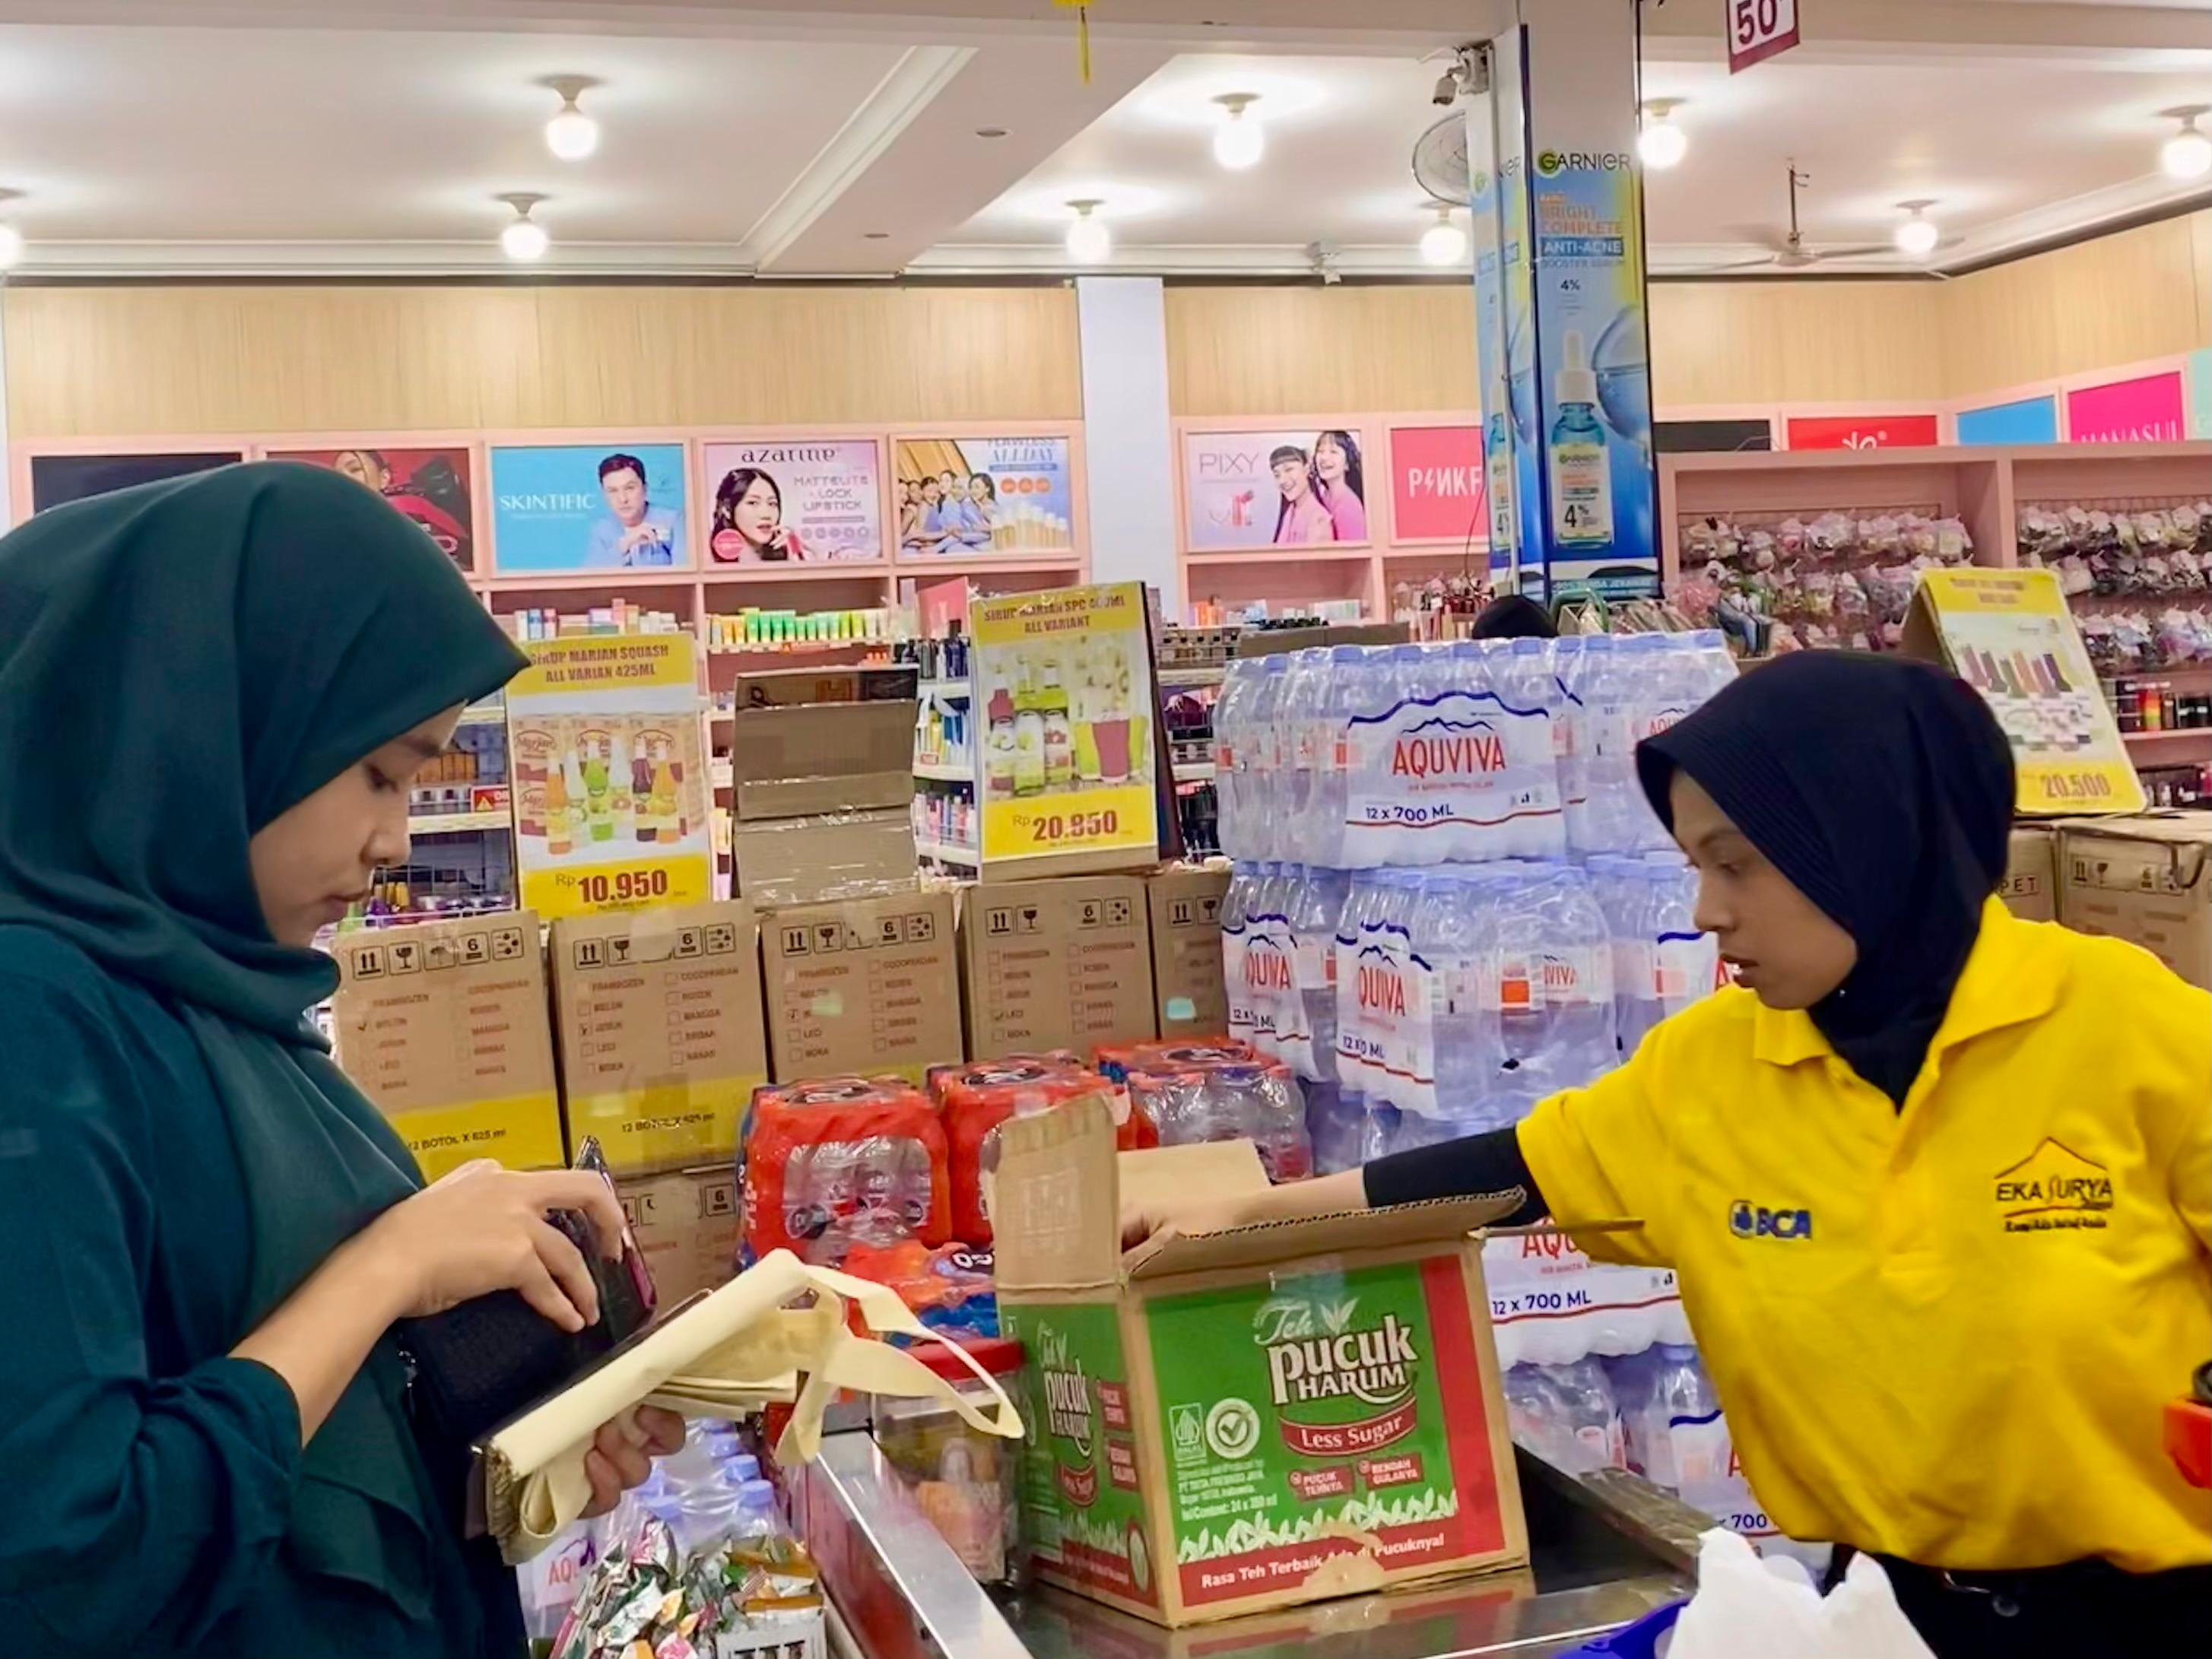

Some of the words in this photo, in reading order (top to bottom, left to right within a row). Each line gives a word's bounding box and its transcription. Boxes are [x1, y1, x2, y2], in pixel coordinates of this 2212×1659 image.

[1544, 239, 1622, 254] ANTI-ACNE
[1199, 452, 1260, 475] PIXY
[1408, 465, 1482, 499] PINKF
[499, 493, 597, 511] SKINTIFIC
[620, 644, 669, 661] SQUASH
[545, 669, 565, 683] ALL
[1392, 735, 1506, 779] AQUVIVA
[2041, 773, 2112, 798] 20.500
[1365, 807, 1378, 820] 12
[1393, 806, 1428, 822] 700
[1432, 804, 1455, 818] ML
[555, 874, 576, 889] Rp
[578, 869, 668, 904] 10.950
[884, 921, 894, 933] 6
[467, 938, 478, 950] 6
[682, 933, 693, 945] 6
[422, 1136, 459, 1150] BOTOL
[462, 1134, 470, 1143] X
[715, 1189, 725, 1203] 6
[1996, 1181, 2043, 1201] EKA
[2045, 1175, 2113, 1204] SURYA
[1756, 1207, 1813, 1239] BCA
[1492, 1299, 1506, 1315] 12
[1525, 1292, 1562, 1310] 700
[1566, 1291, 1592, 1308] ML
[1253, 1297, 1314, 1346] Teh
[1297, 1364, 1412, 1404] HARUM
[1301, 1429, 1343, 1449] Less
[1347, 1414, 1403, 1444] Sugar
[1303, 1470, 1338, 1486] PUCUK
[1731, 1513, 1768, 1529] 700
[1201, 1572, 1236, 1589] Rasa
[1239, 1565, 1266, 1581] Teh
[1268, 1555, 1324, 1576] Terbaik
